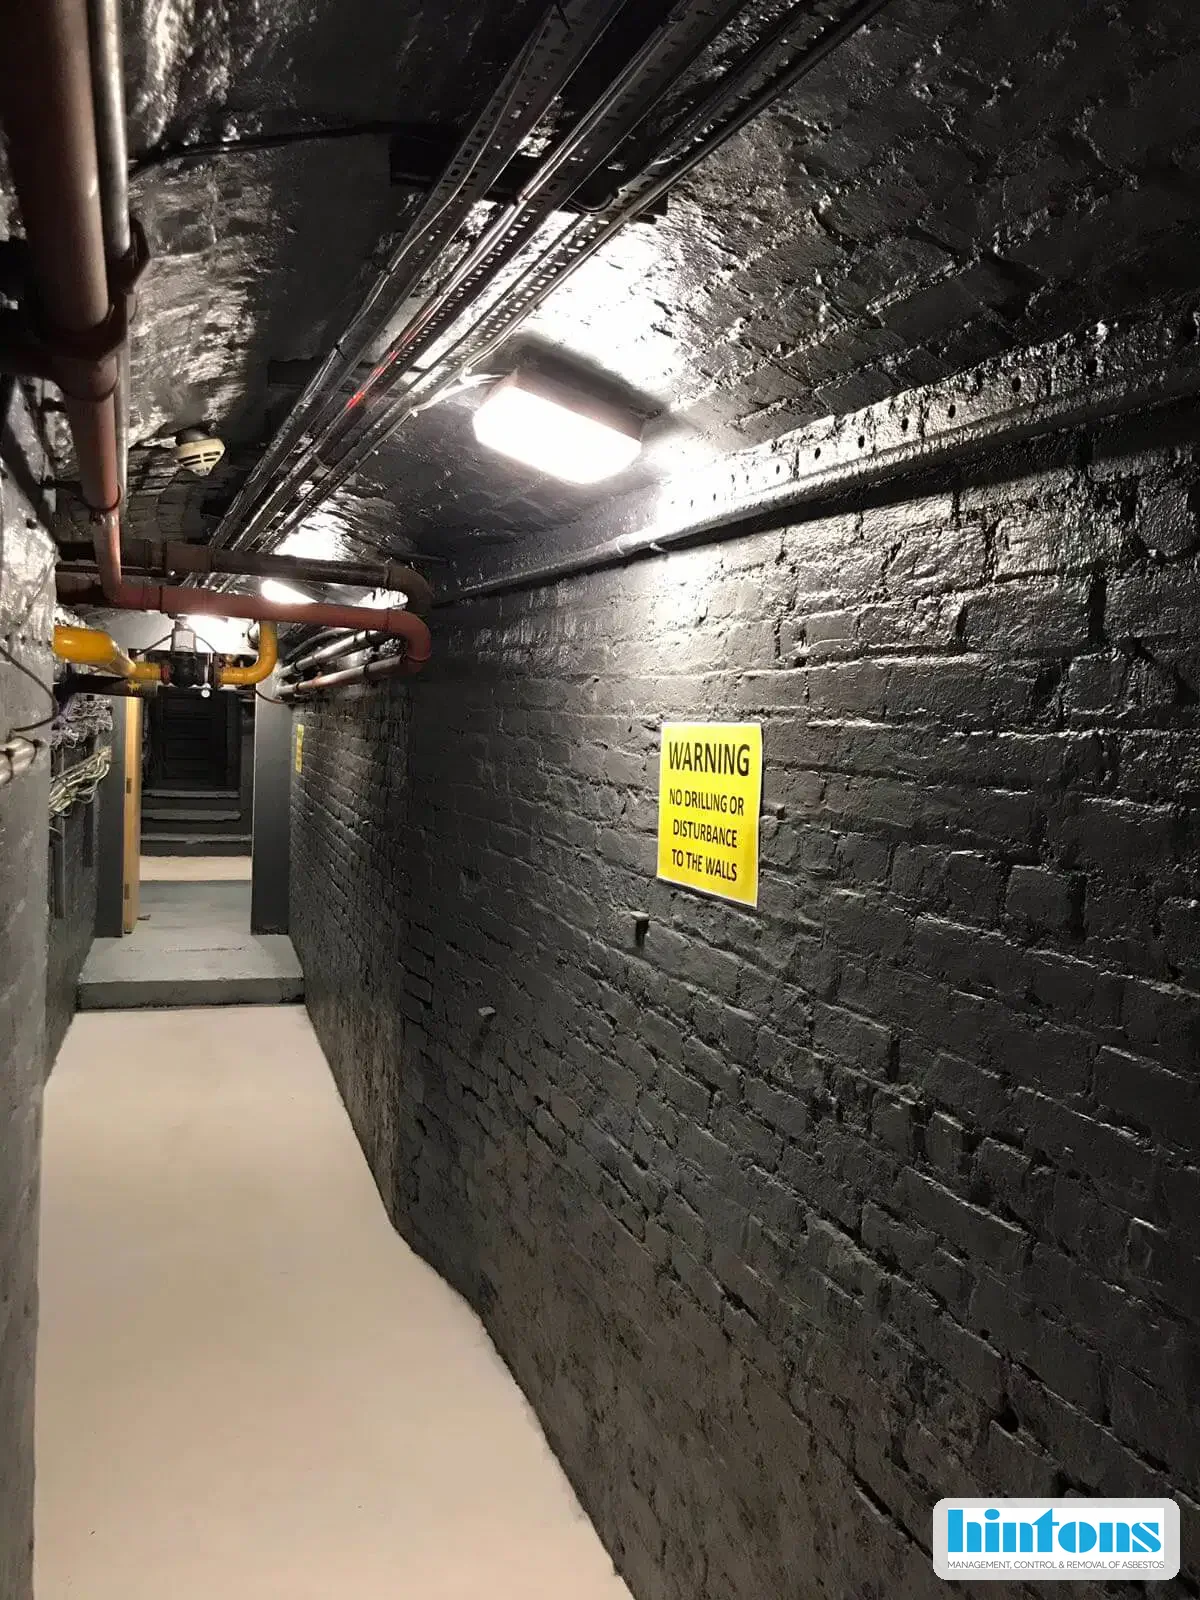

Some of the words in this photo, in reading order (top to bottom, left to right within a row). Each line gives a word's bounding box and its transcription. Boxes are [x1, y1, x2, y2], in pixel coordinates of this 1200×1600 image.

[669, 741, 750, 776] WARNING
[669, 788, 682, 806] NO
[685, 790, 727, 812] DRILLING
[730, 796, 744, 816] OR
[673, 819, 737, 848] DISTURBANCE
[672, 849, 683, 867] TO
[686, 852, 702, 872] THE
[705, 856, 737, 882] WALLS
